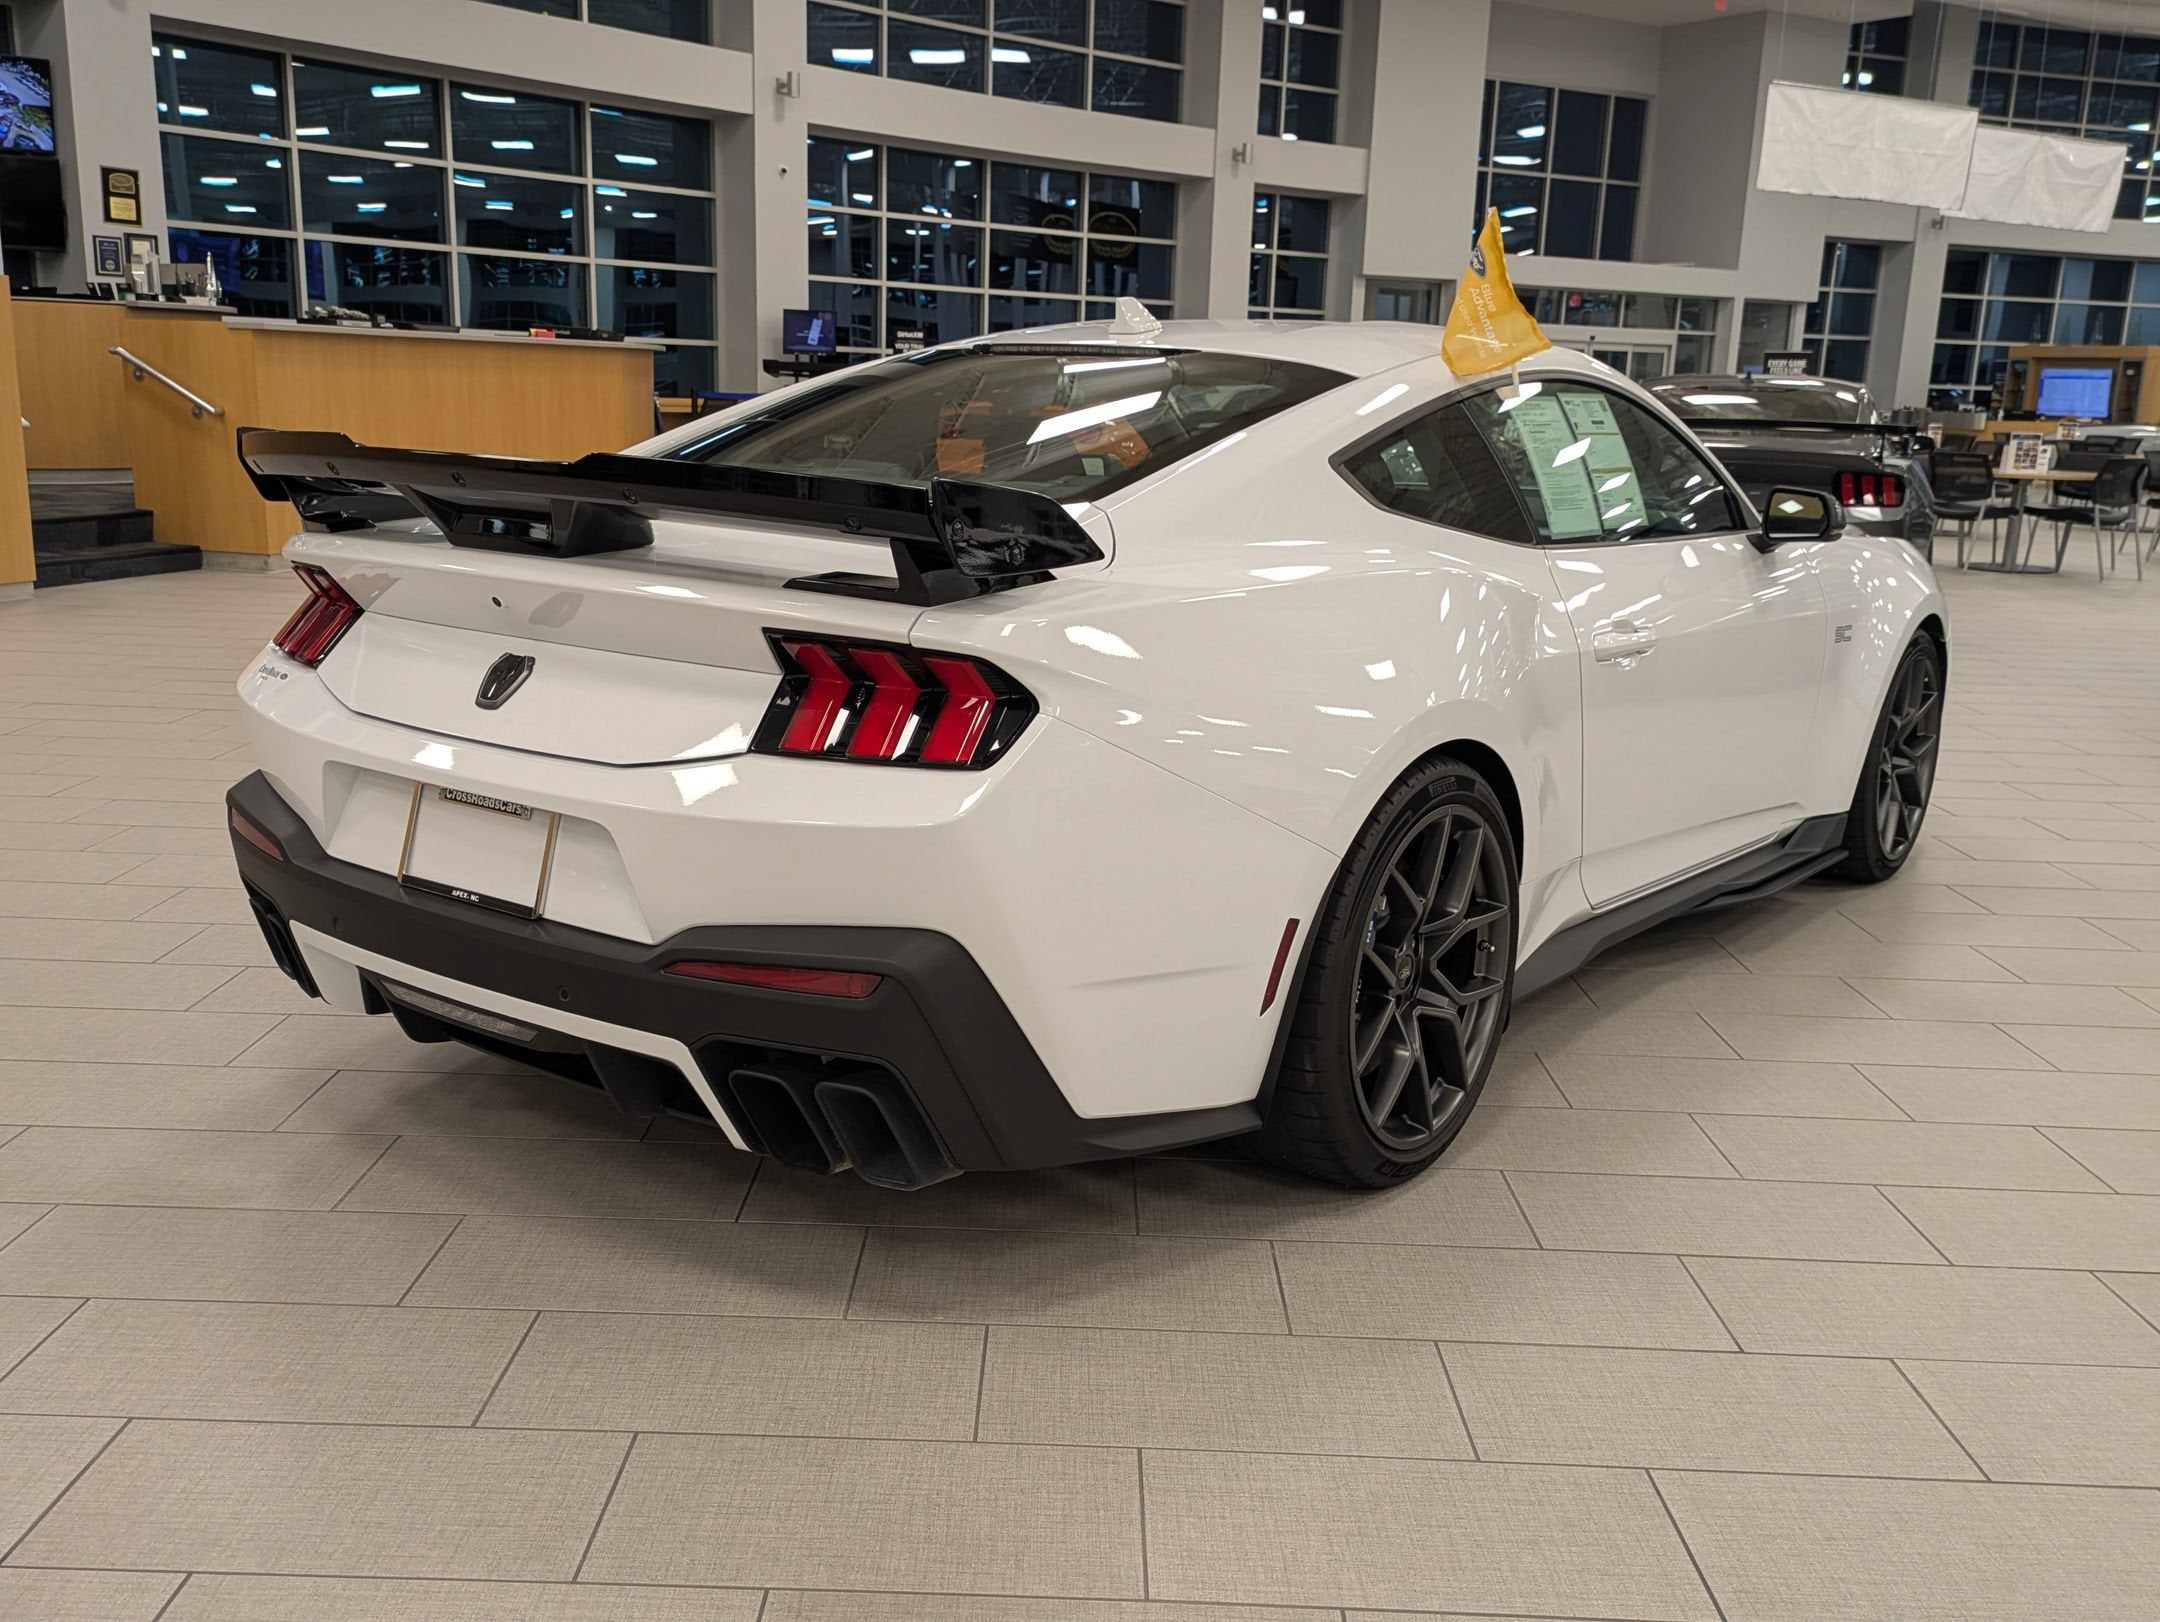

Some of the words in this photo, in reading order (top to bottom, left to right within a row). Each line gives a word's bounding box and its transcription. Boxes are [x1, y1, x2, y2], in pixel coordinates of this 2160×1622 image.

[1481, 283, 1496, 313] Blue
[1469, 287, 1502, 353] Advantage
[446, 787, 521, 815] CrossRoadsCars
[470, 894, 480, 902] NC
